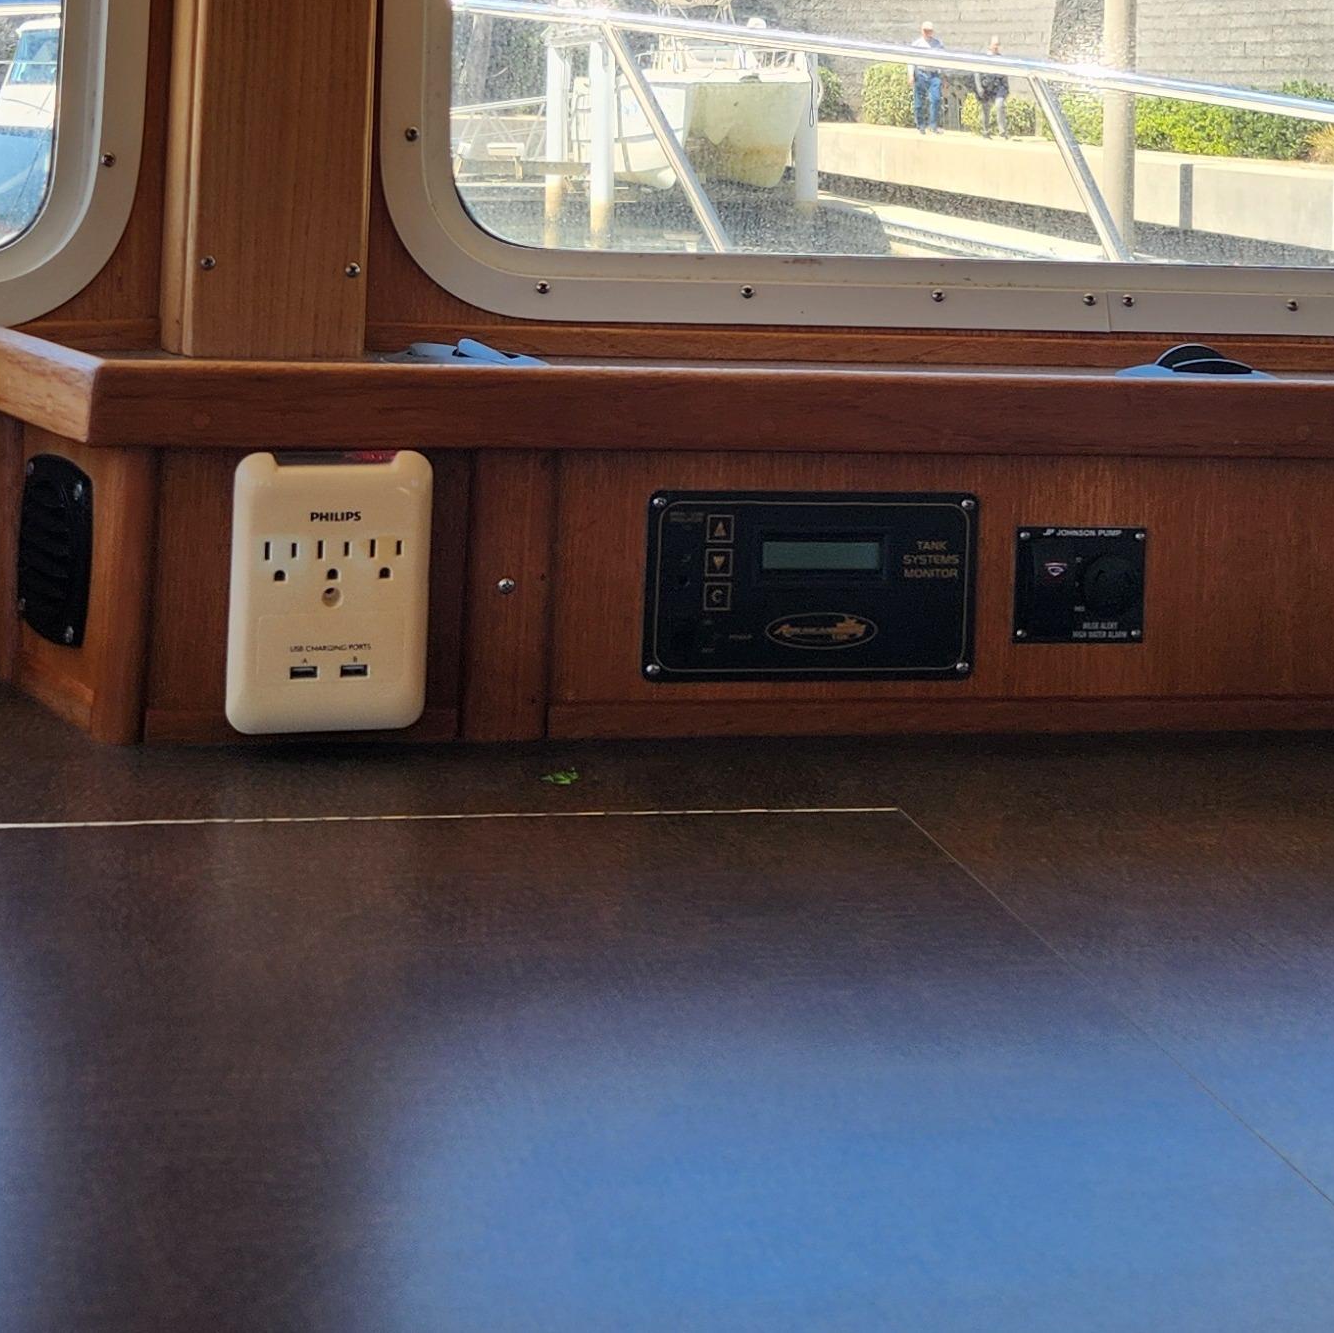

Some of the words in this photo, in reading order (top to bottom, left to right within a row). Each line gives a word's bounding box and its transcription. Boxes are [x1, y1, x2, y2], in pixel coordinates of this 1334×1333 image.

[310, 511, 362, 522] PHILIPS
[916, 540, 948, 551] TANK
[902, 554, 960, 565] SYSTEMS
[903, 568, 959, 579] MONITOR
